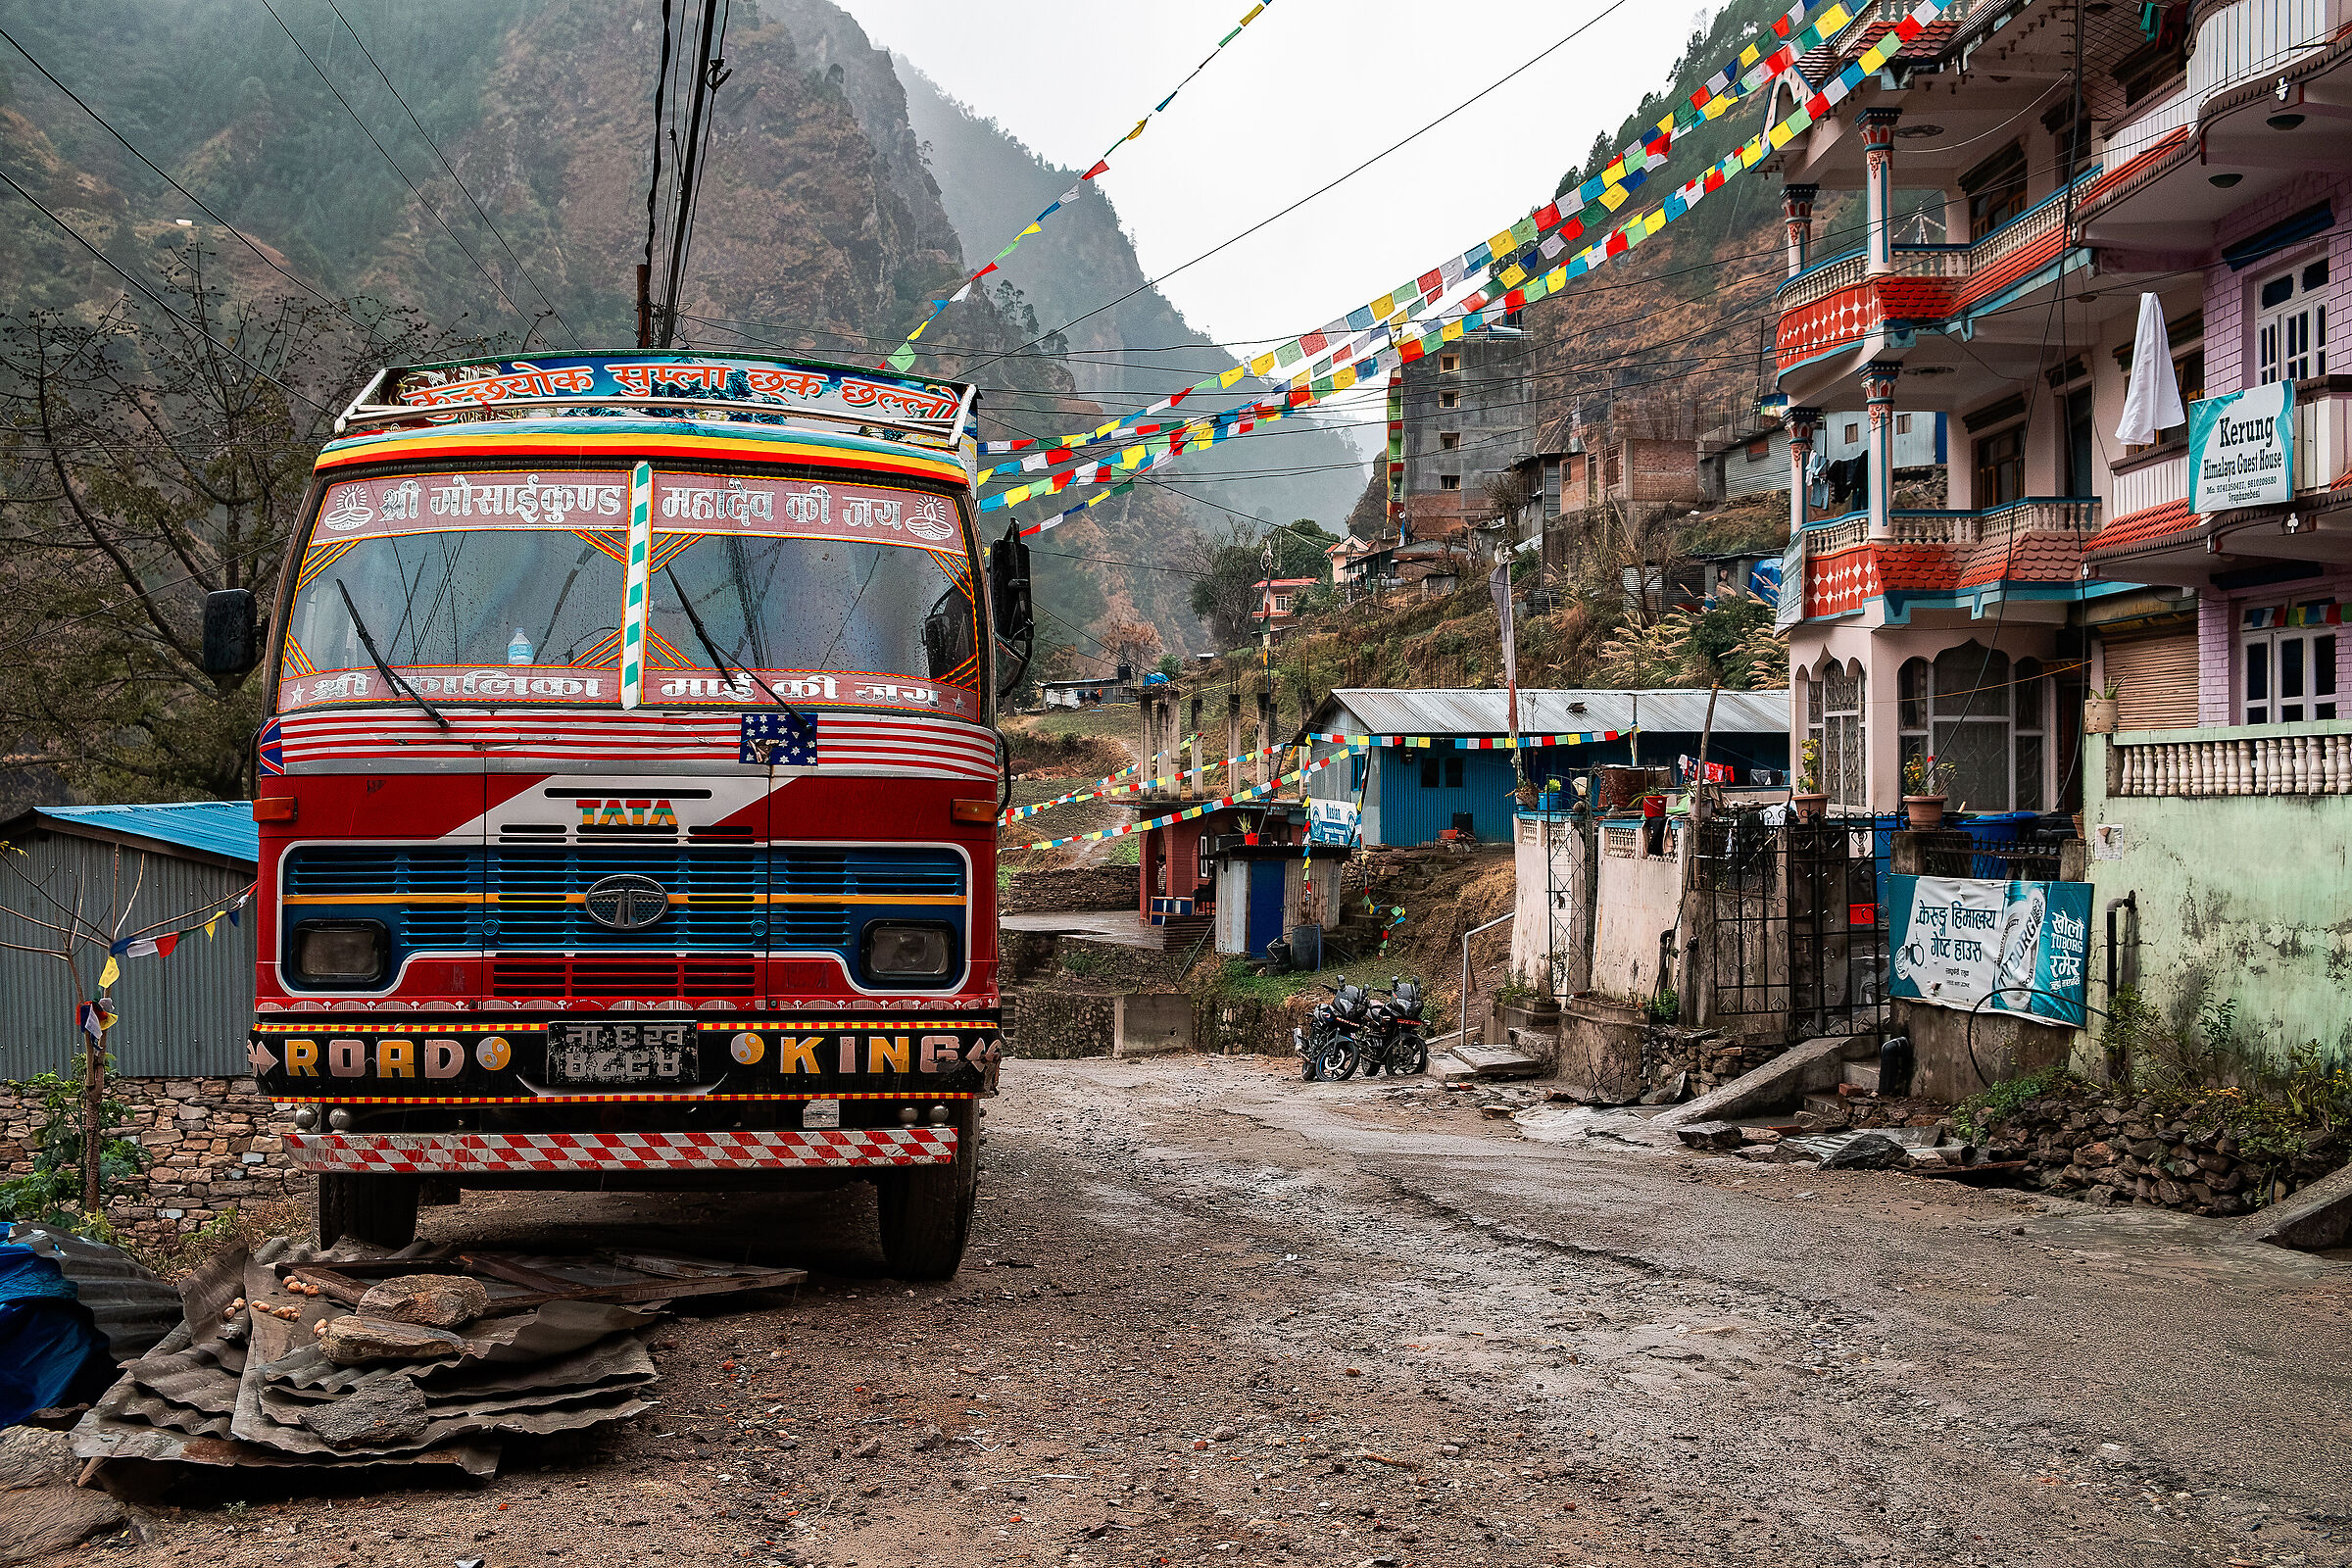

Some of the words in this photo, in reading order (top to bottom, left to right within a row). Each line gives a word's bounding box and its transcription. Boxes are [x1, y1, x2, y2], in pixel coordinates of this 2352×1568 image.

[2220, 416, 2275, 448] Kerung
[2203, 456, 2236, 482] Himalaya
[2236, 452, 2259, 475] Guest
[2259, 448, 2282, 471] House
[378, 479, 421, 522] श्री
[661, 478, 775, 526] महादेव
[786, 485, 831, 524] की
[842, 496, 903, 531] जय
[309, 671, 371, 702] श्री
[389, 669, 604, 698] कालिका
[658, 669, 757, 703] माई
[771, 675, 840, 699] की
[855, 681, 943, 708] जय
[576, 800, 678, 825] TATA
[2051, 933, 2083, 954] TUBORG
[284, 1039, 466, 1079] ROAD
[780, 1036, 960, 1074] KING
